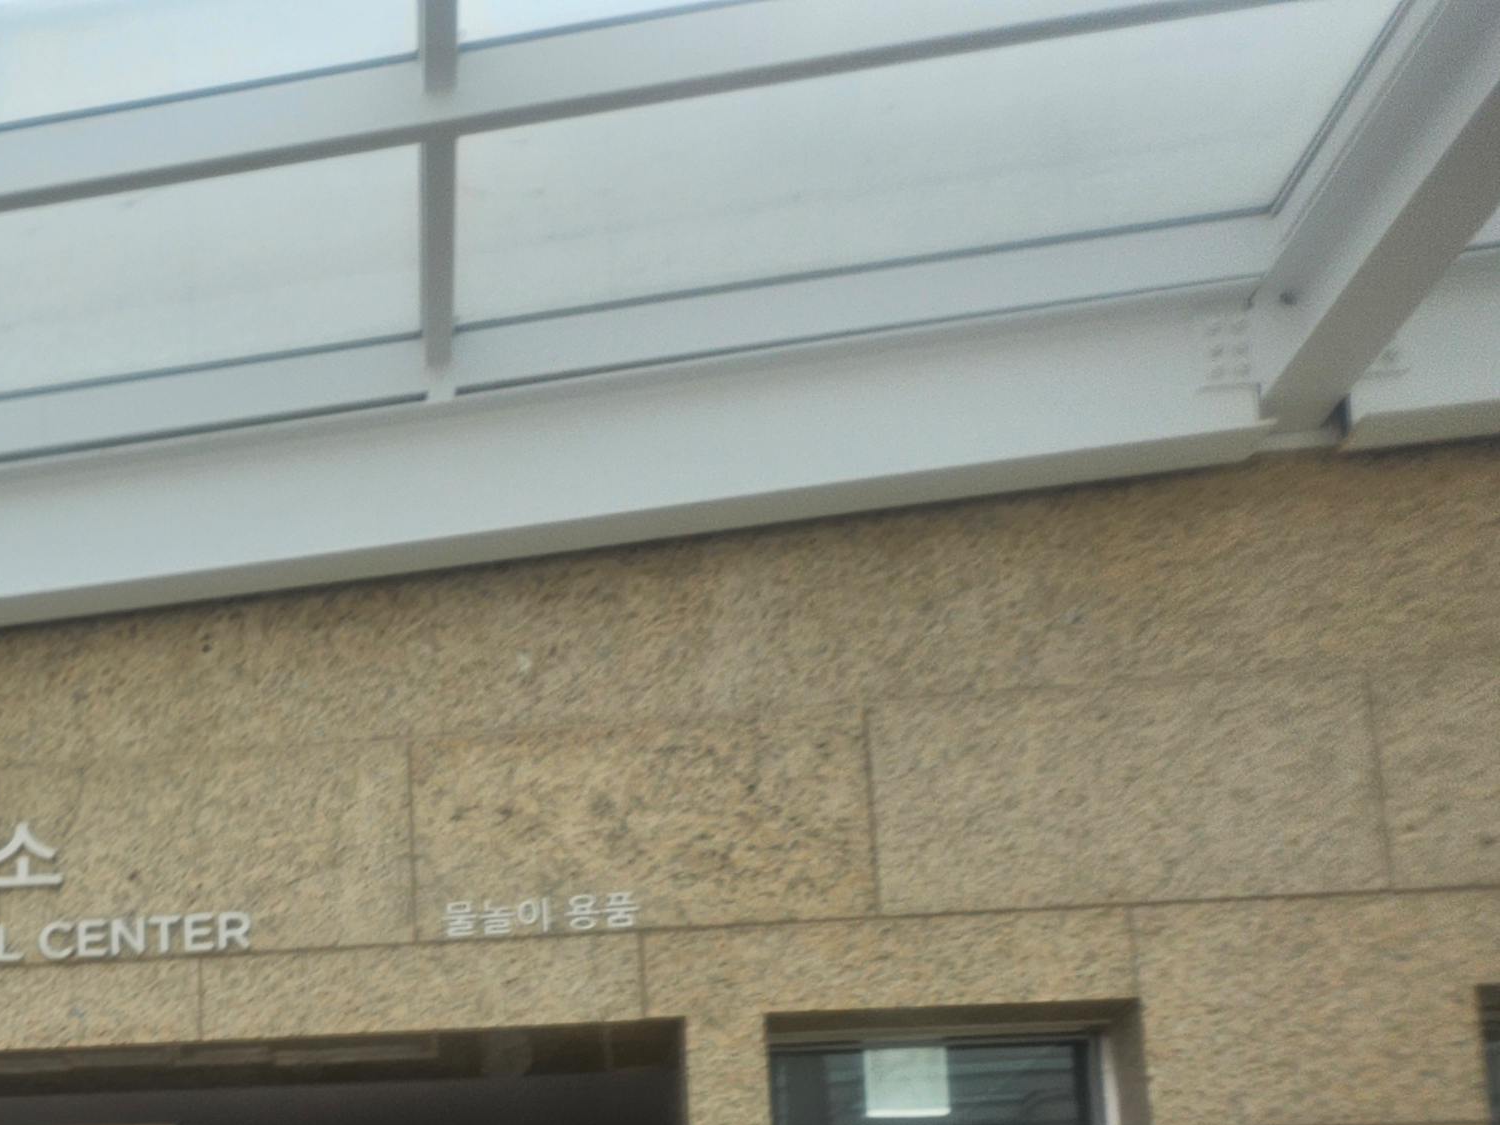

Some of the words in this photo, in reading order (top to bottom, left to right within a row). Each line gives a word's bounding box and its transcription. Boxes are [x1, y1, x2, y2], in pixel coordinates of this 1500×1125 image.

[38, 910, 251, 959] CENTER
[443, 896, 550, 938] 물놀이
[563, 891, 641, 930] 용품
